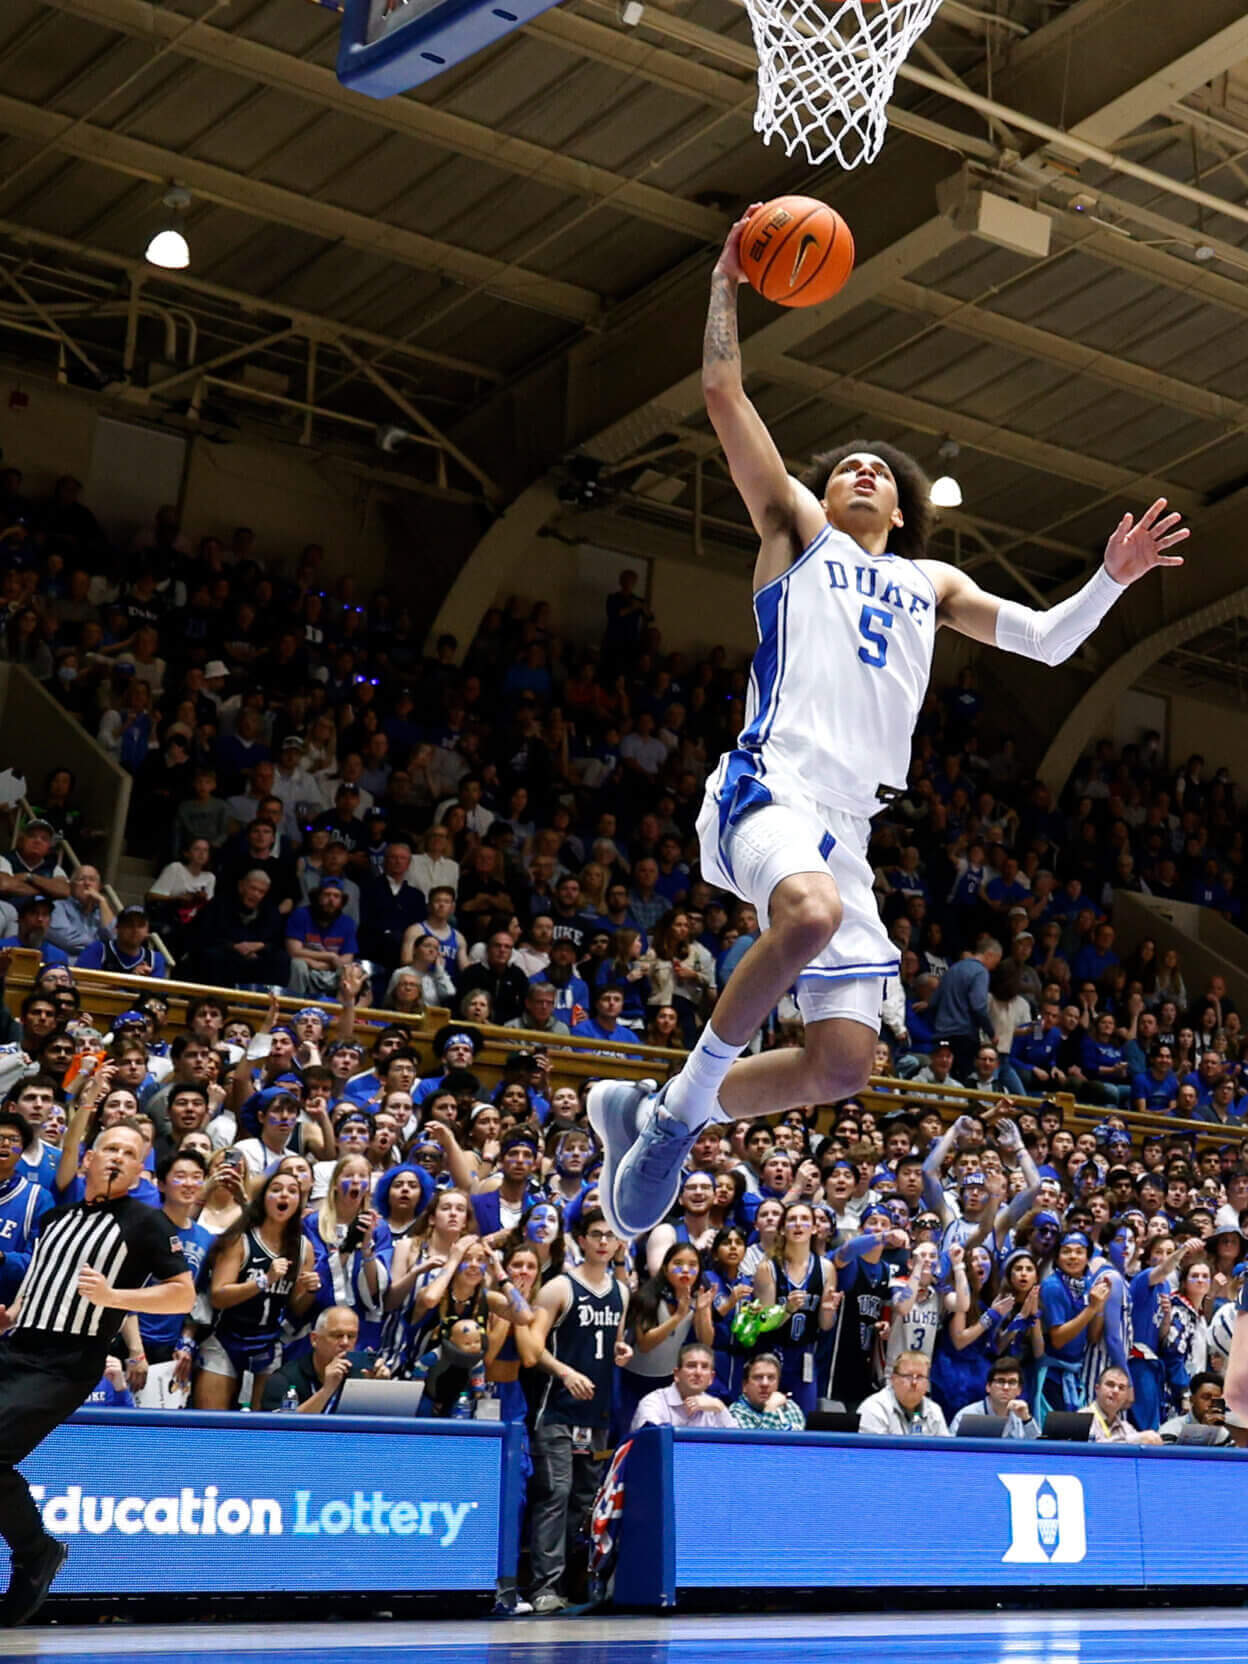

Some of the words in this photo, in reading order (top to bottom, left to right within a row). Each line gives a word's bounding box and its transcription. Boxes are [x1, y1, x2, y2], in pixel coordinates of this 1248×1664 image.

[858, 603, 894, 669] 5
[552, 925, 584, 947] UKE
[578, 1303, 622, 1327] Duke
[789, 1312, 807, 1342] 0
[594, 1331, 604, 1360] 1
[910, 1328, 926, 1351] 3
[293, 1491, 471, 1547] Lottery
